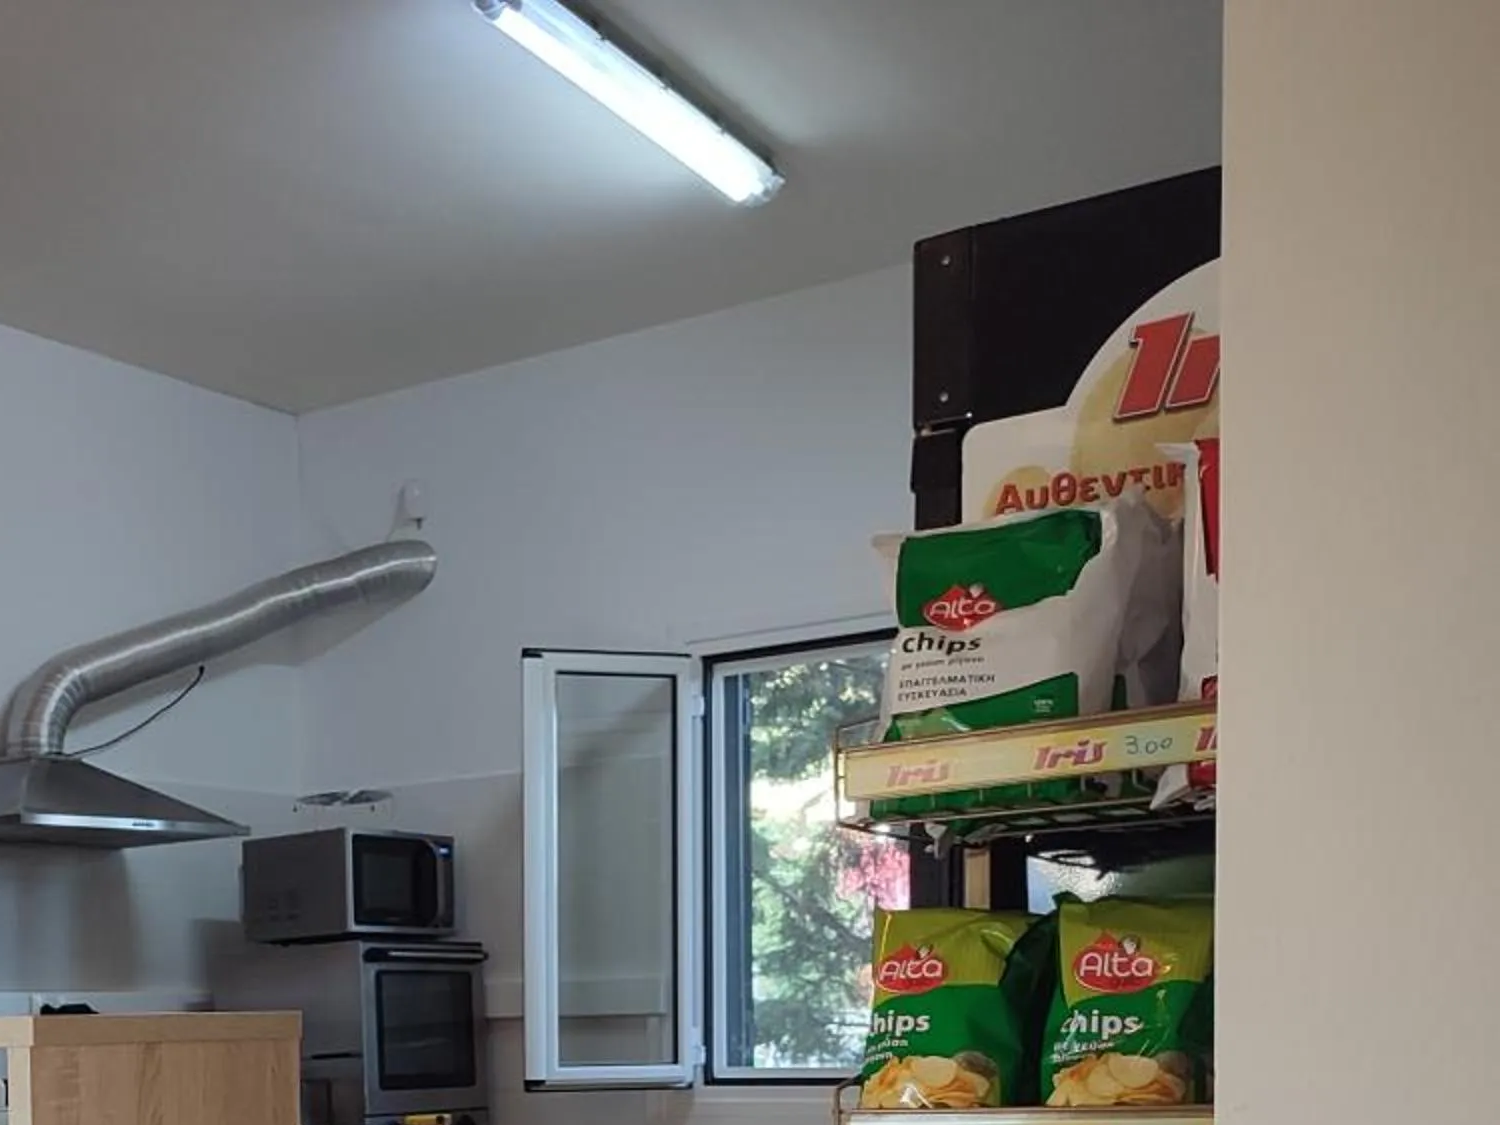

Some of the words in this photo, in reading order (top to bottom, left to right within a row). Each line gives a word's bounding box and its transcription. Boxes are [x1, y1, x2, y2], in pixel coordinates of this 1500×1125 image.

[902, 632, 982, 656] chips
[1033, 739, 1108, 771] Iris
[879, 959, 943, 981] Alta
[1079, 950, 1154, 978] Alta
[870, 1010, 931, 1036] hips
